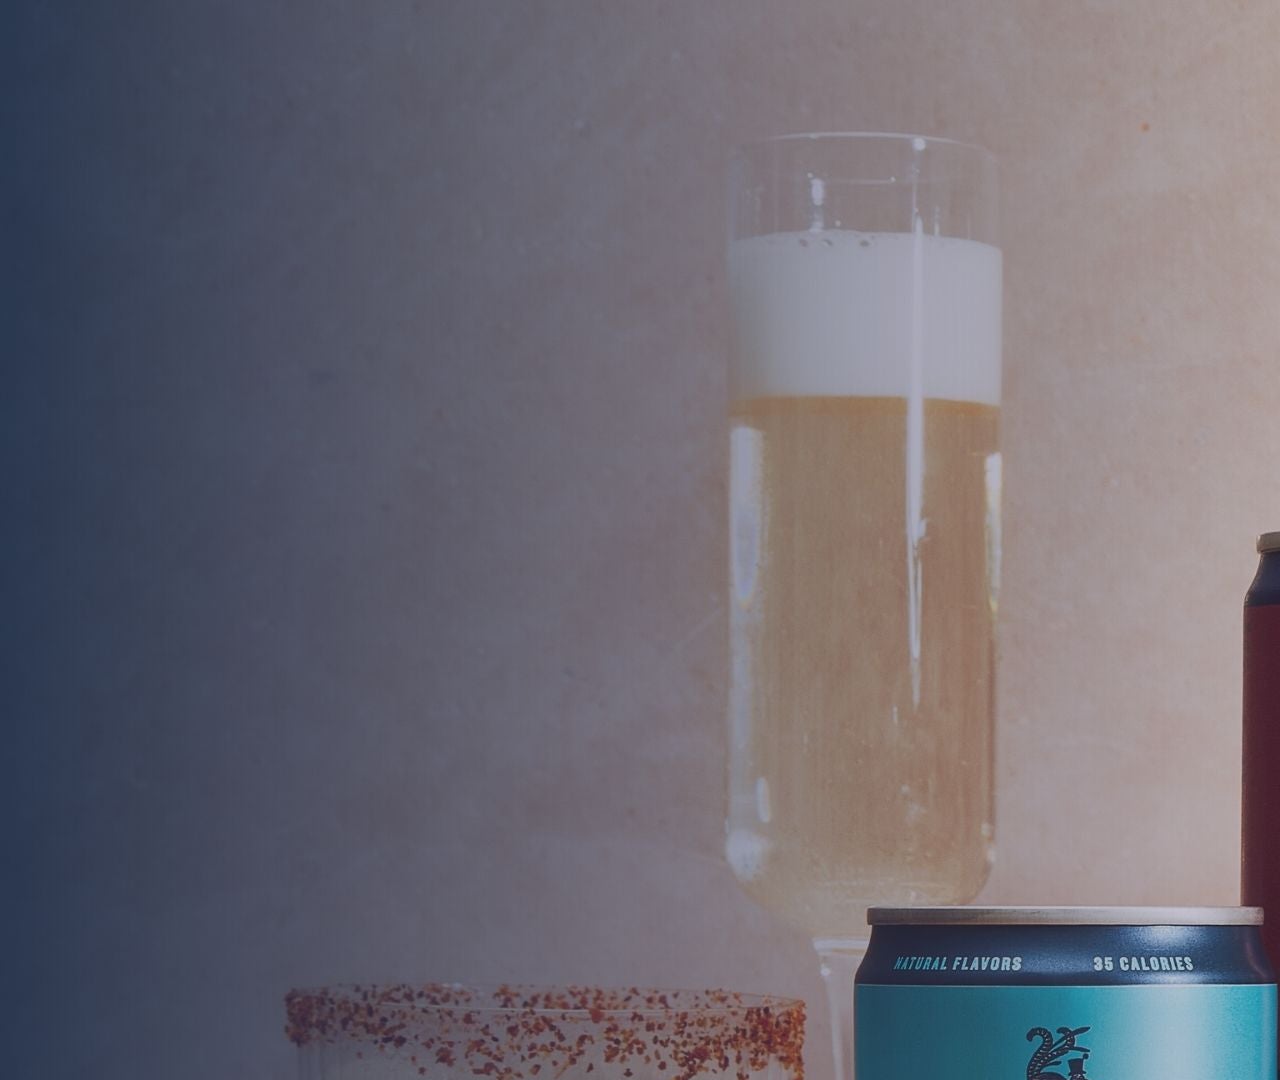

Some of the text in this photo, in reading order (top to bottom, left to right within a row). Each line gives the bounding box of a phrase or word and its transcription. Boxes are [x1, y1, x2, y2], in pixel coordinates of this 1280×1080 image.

[894, 956, 1022, 972] NATURAL FLAVORS
[1093, 956, 1194, 971] 35 CALORIES
